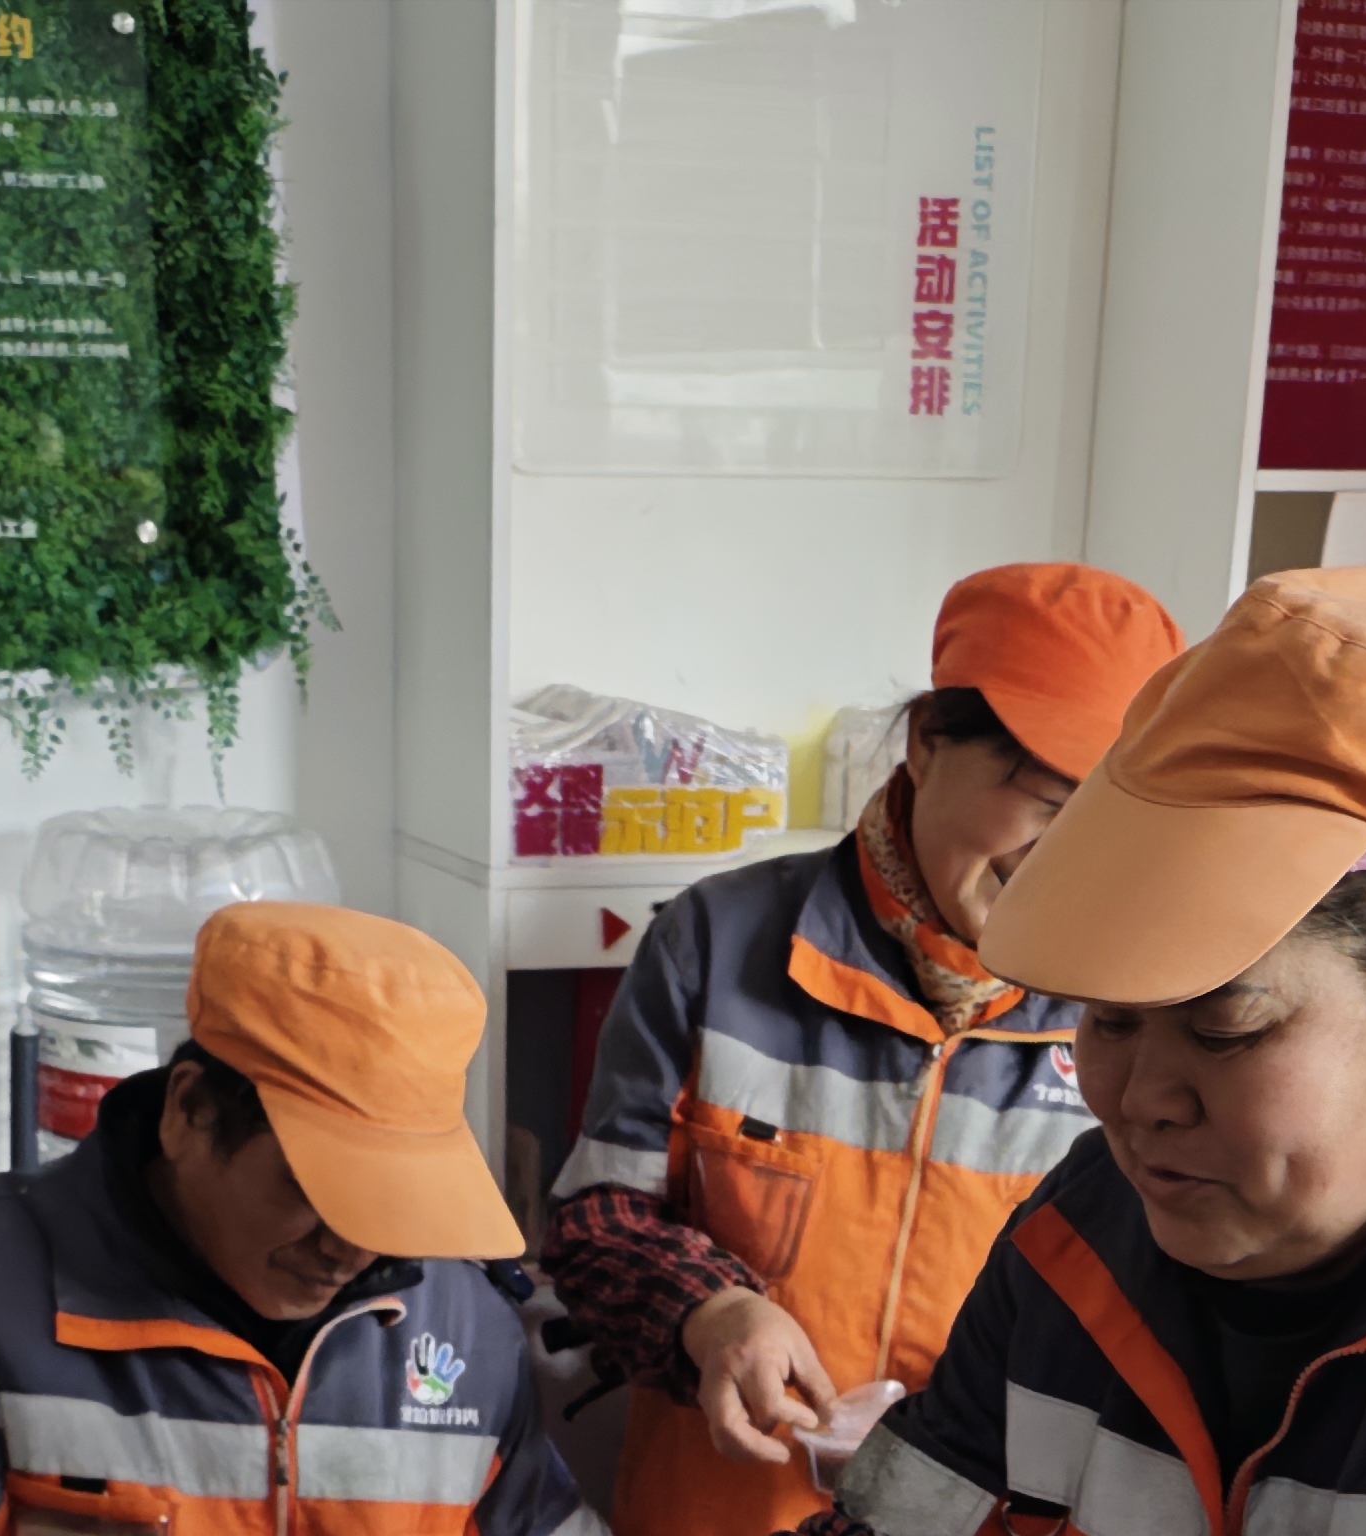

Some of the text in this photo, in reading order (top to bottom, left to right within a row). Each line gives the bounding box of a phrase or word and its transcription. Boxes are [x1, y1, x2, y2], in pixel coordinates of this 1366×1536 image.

[908, 196, 961, 416] 活动安排
[961, 126, 996, 416] LIST OF ACTIVITIES
